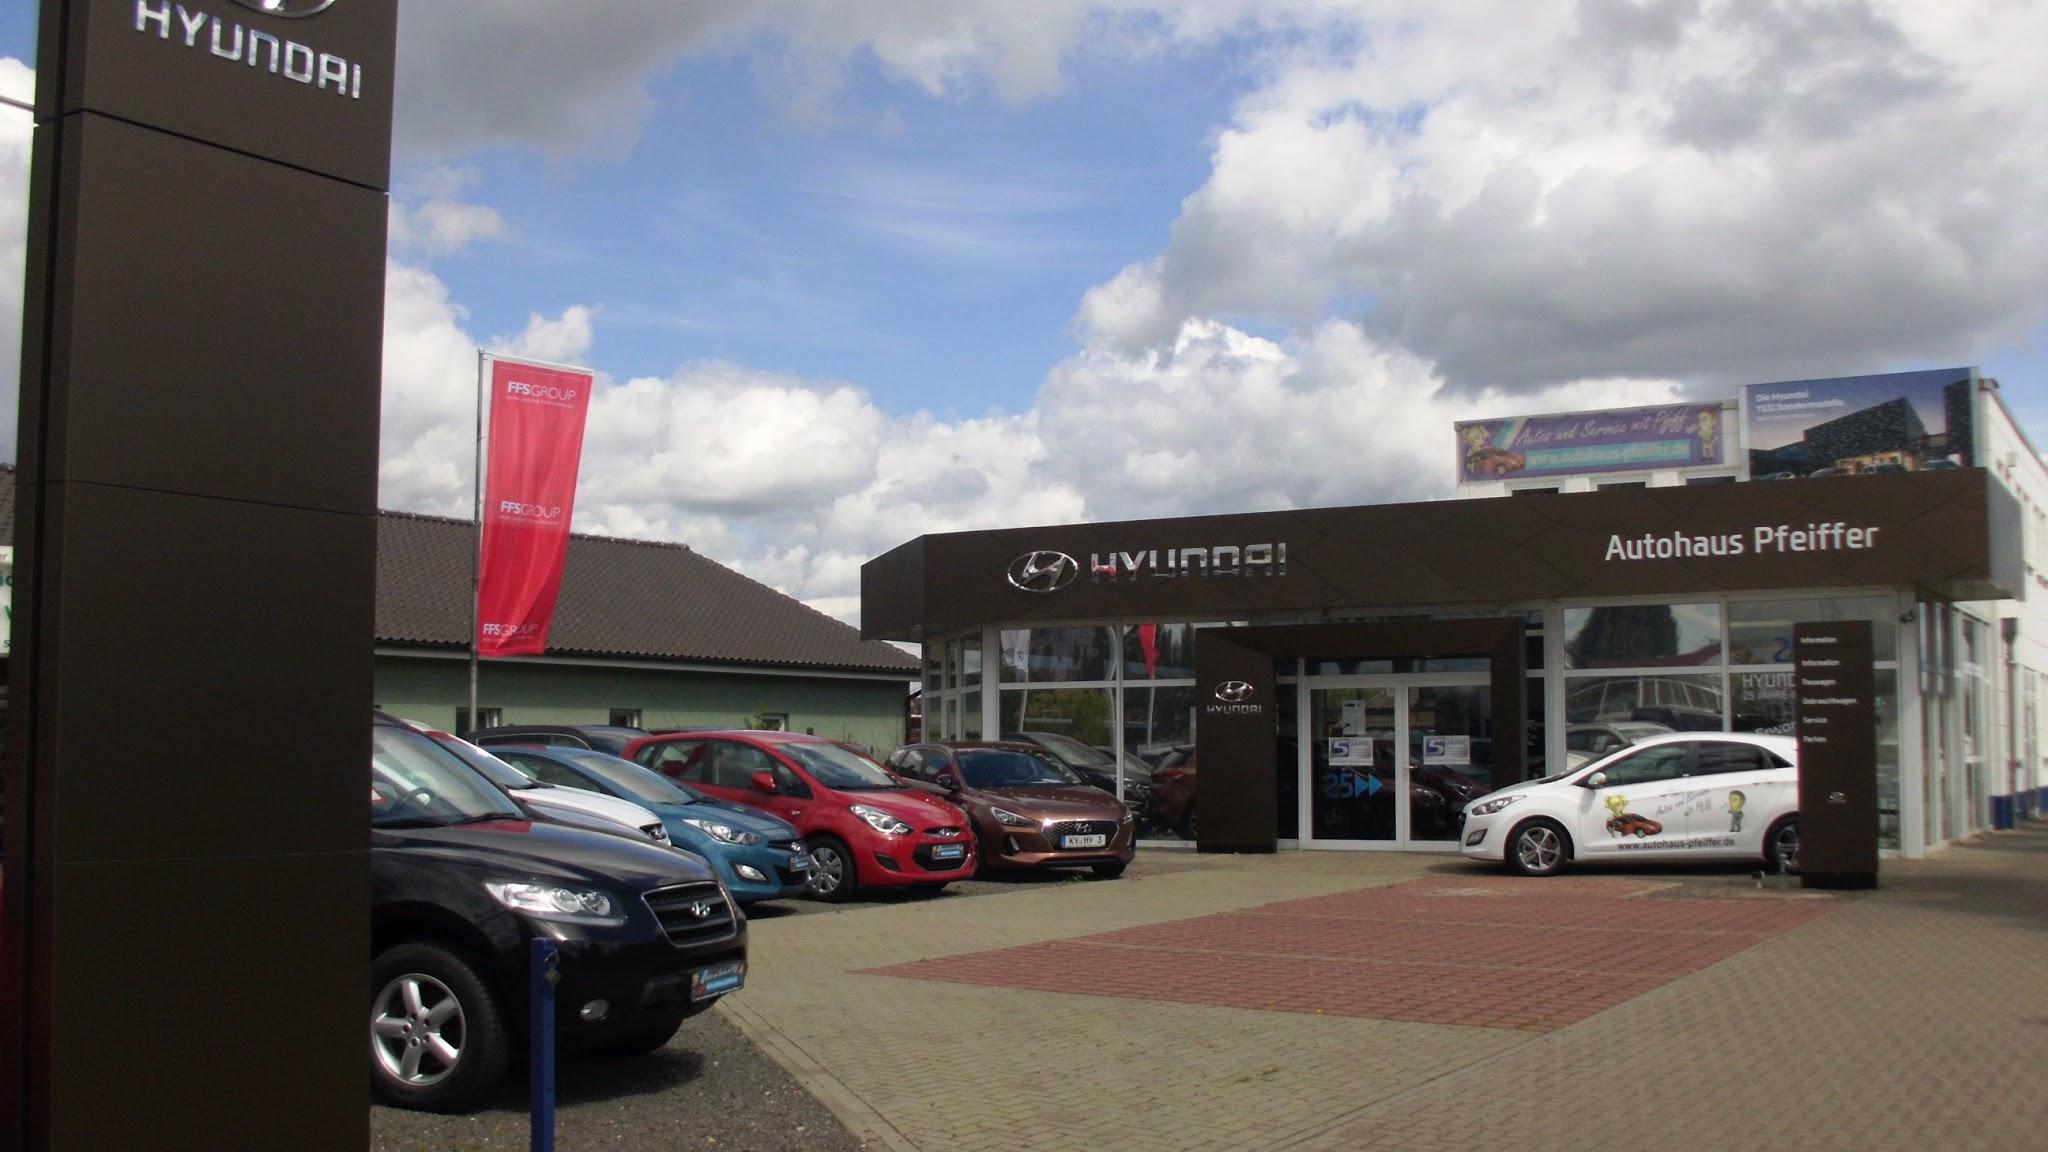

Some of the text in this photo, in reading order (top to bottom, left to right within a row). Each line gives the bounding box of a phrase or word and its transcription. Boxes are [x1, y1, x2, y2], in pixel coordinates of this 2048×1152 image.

[135, 0, 362, 99] HYUNDAI
[1605, 522, 1880, 561] Autohaus Pfeiffer
[1091, 542, 1287, 583] HYUNDAI
[1207, 705, 1262, 714] HYUNDAI
[1617, 837, 1735, 850] www.autohaus-pfeiffer.de
